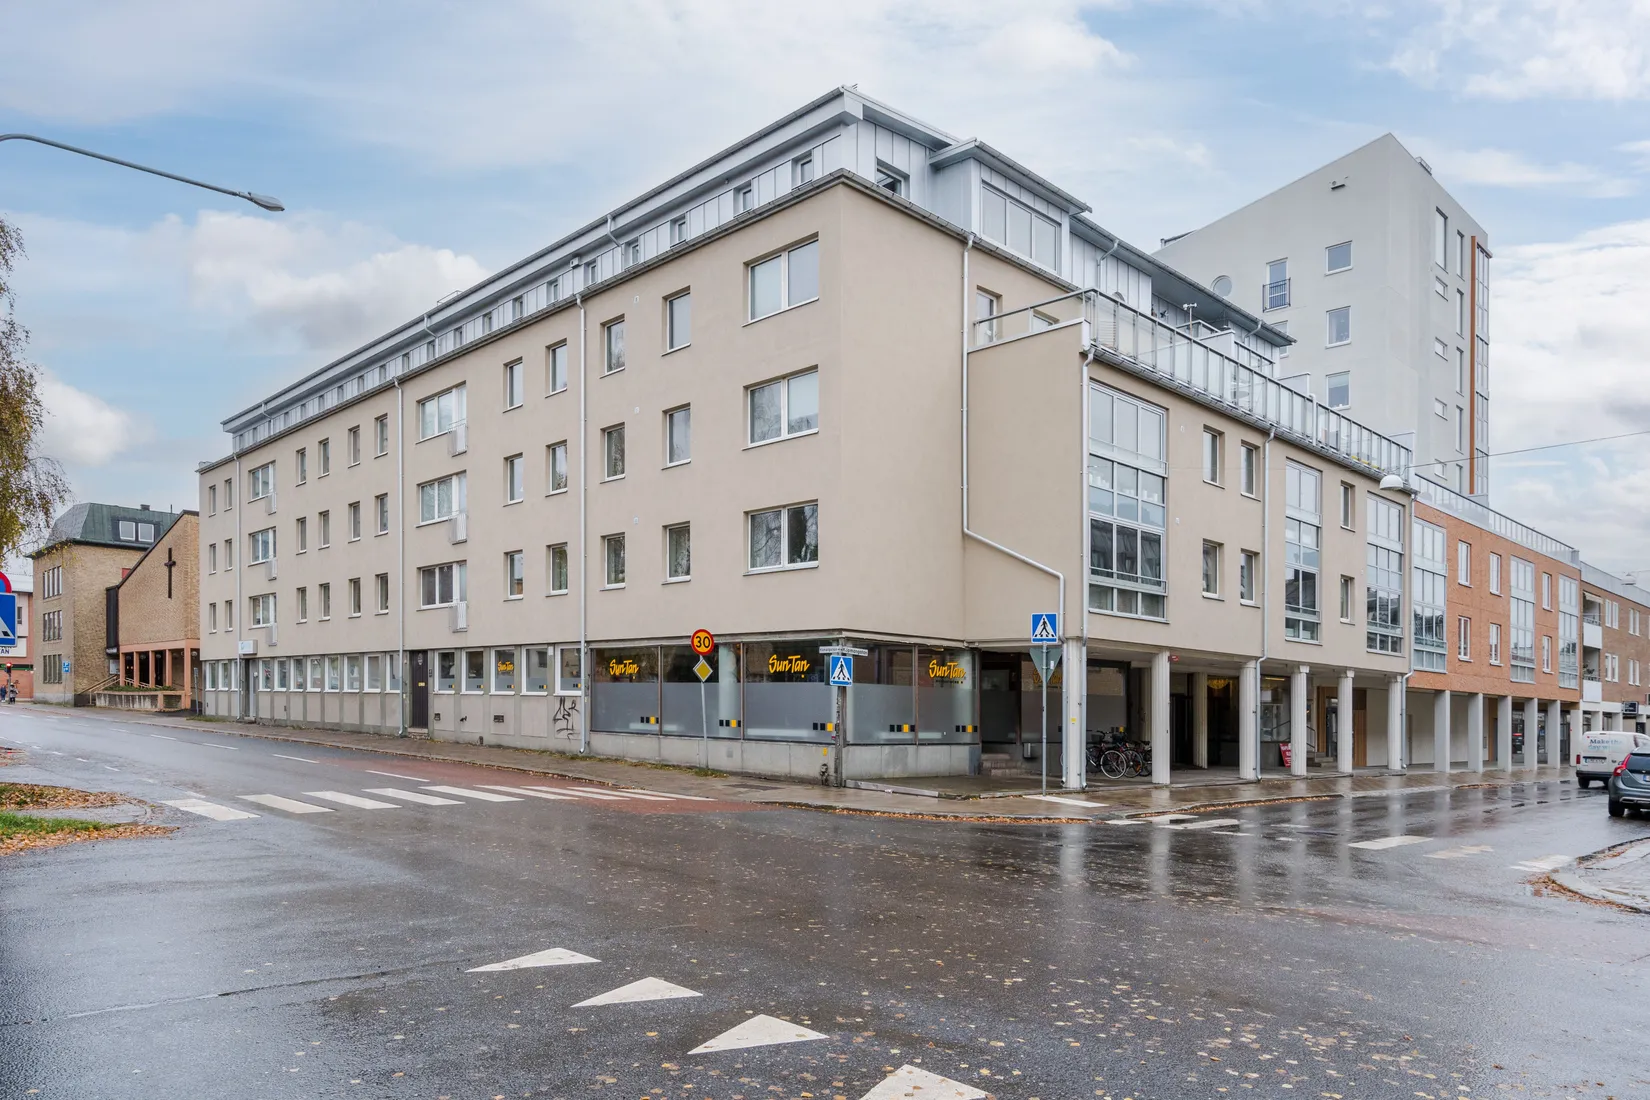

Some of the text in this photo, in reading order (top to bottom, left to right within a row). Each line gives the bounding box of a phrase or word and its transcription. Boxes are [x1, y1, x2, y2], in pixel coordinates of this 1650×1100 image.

[695, 635, 711, 648] 30
[609, 659, 639, 675] SunTan
[769, 654, 810, 673] SunTan
[928, 659, 967, 679] SunTan
